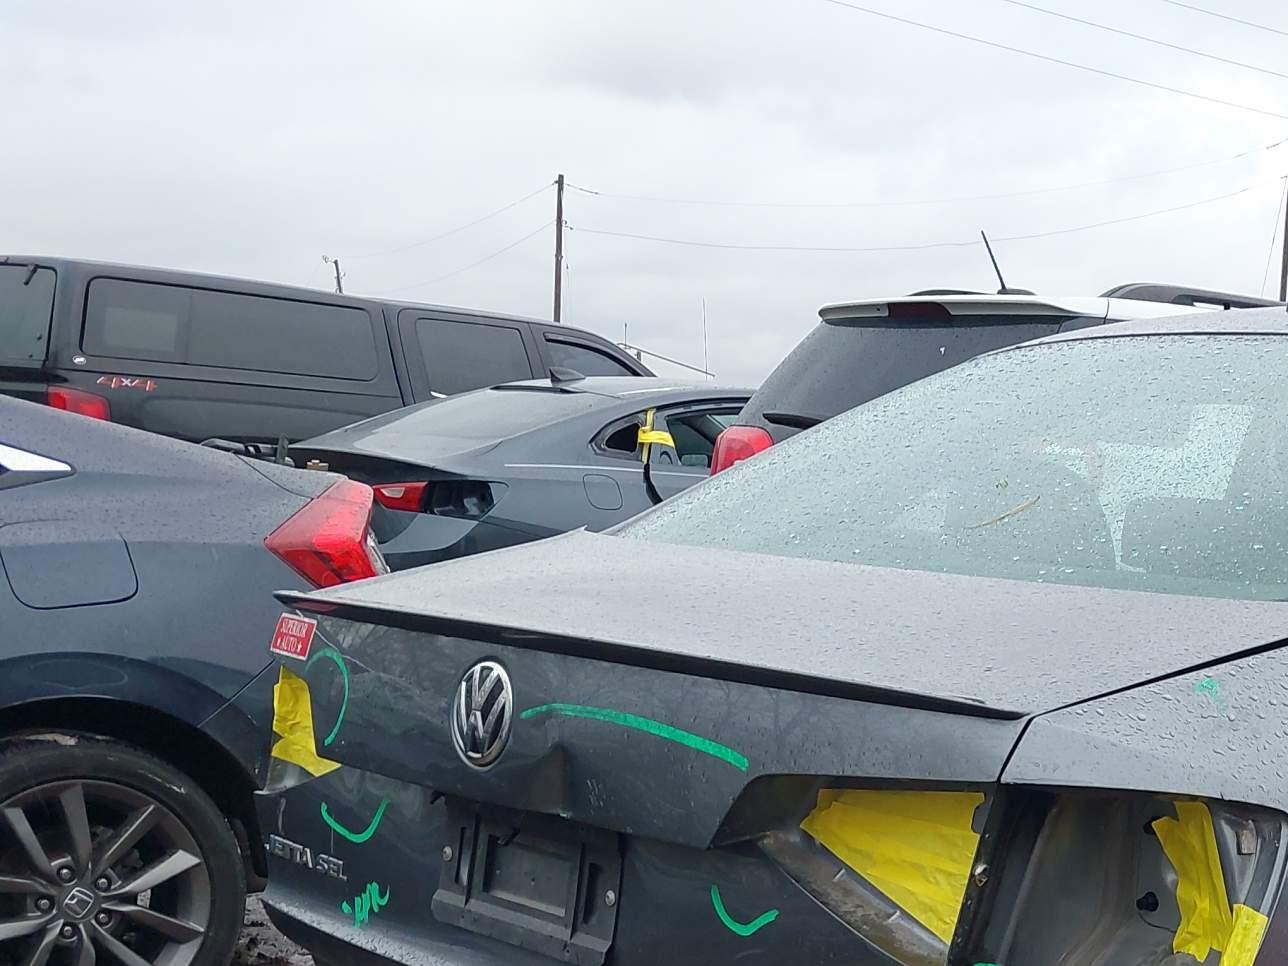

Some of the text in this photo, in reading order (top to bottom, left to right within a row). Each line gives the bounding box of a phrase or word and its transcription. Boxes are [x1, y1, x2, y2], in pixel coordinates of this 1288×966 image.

[281, 618, 308, 638] SUPERIOR
[280, 635, 298, 652] AUTO
[316, 853, 348, 881] SEL
